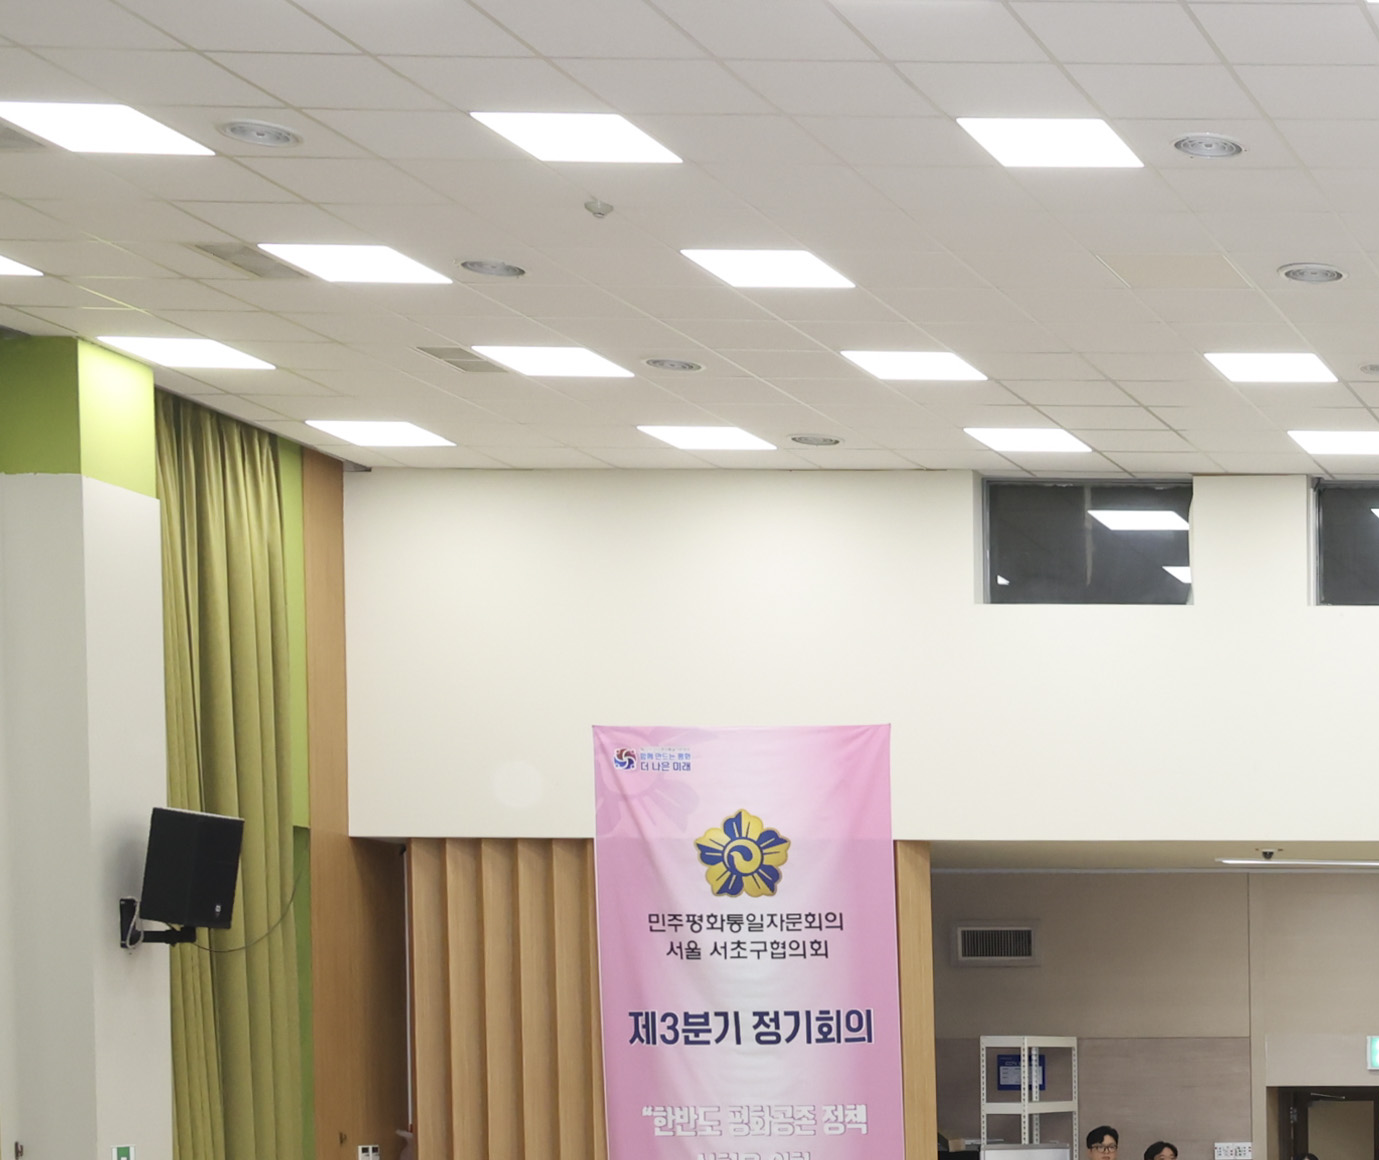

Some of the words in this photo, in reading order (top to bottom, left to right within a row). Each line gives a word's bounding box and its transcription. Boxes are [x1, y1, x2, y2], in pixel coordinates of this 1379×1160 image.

[640, 761, 649, 771] 더
[652, 761, 670, 771] 나은
[672, 761, 691, 771] 미래
[647, 911, 845, 933] 민주평화통일자문회의
[666, 940, 702, 960] 서울
[710, 939, 829, 960] 서초구협의회
[628, 1010, 743, 1046] 제3분기
[752, 1008, 874, 1045] 정기회의
[727, 1104, 817, 1137] 평화공존
[821, 1103, 869, 1136] 정책
